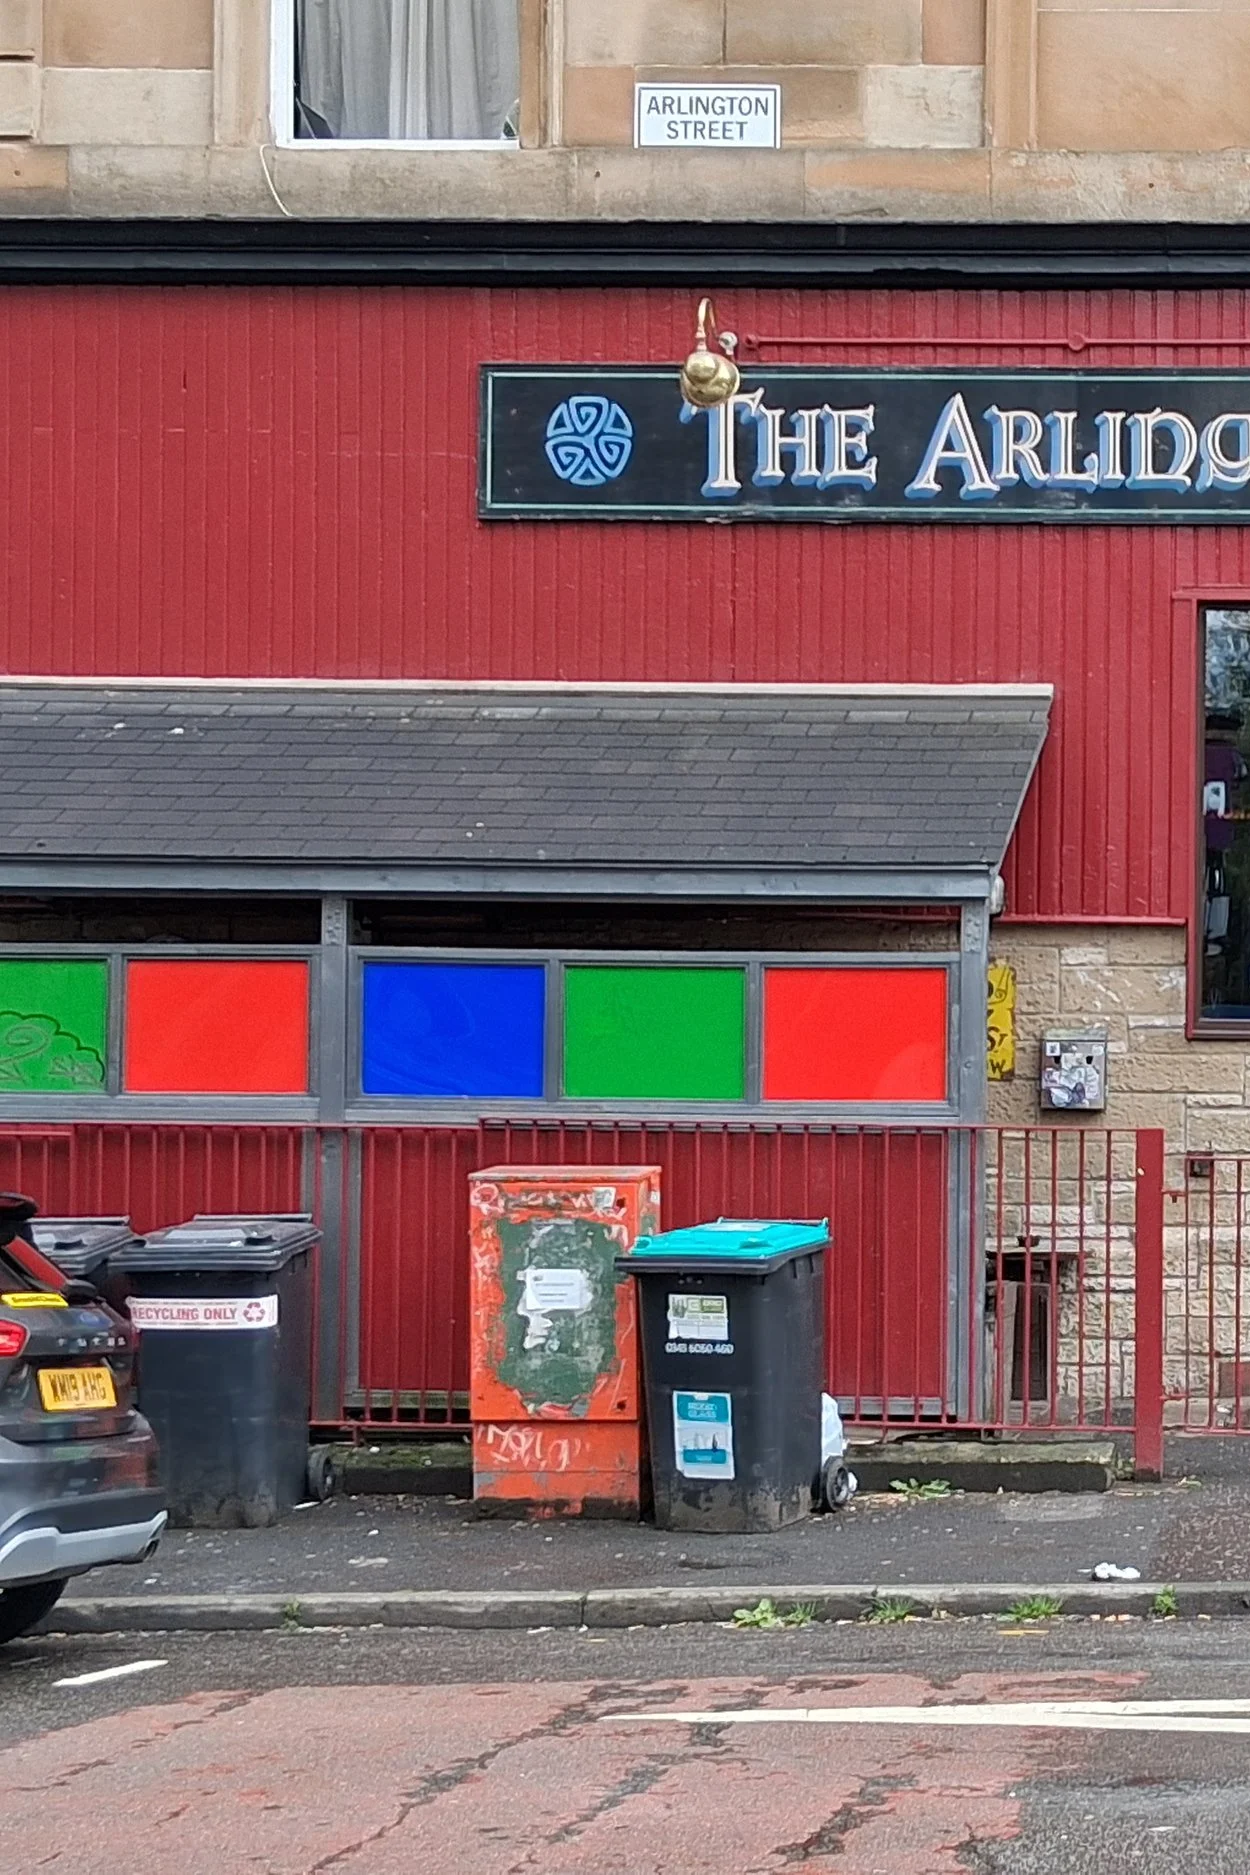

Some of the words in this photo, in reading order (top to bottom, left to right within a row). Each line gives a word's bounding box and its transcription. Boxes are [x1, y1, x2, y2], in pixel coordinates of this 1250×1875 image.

[646, 95, 769, 116] ARLINGTON
[666, 120, 748, 141] STREET
[132, 1306, 199, 1320] RECYCLING
[203, 1307, 238, 1320] ONLY
